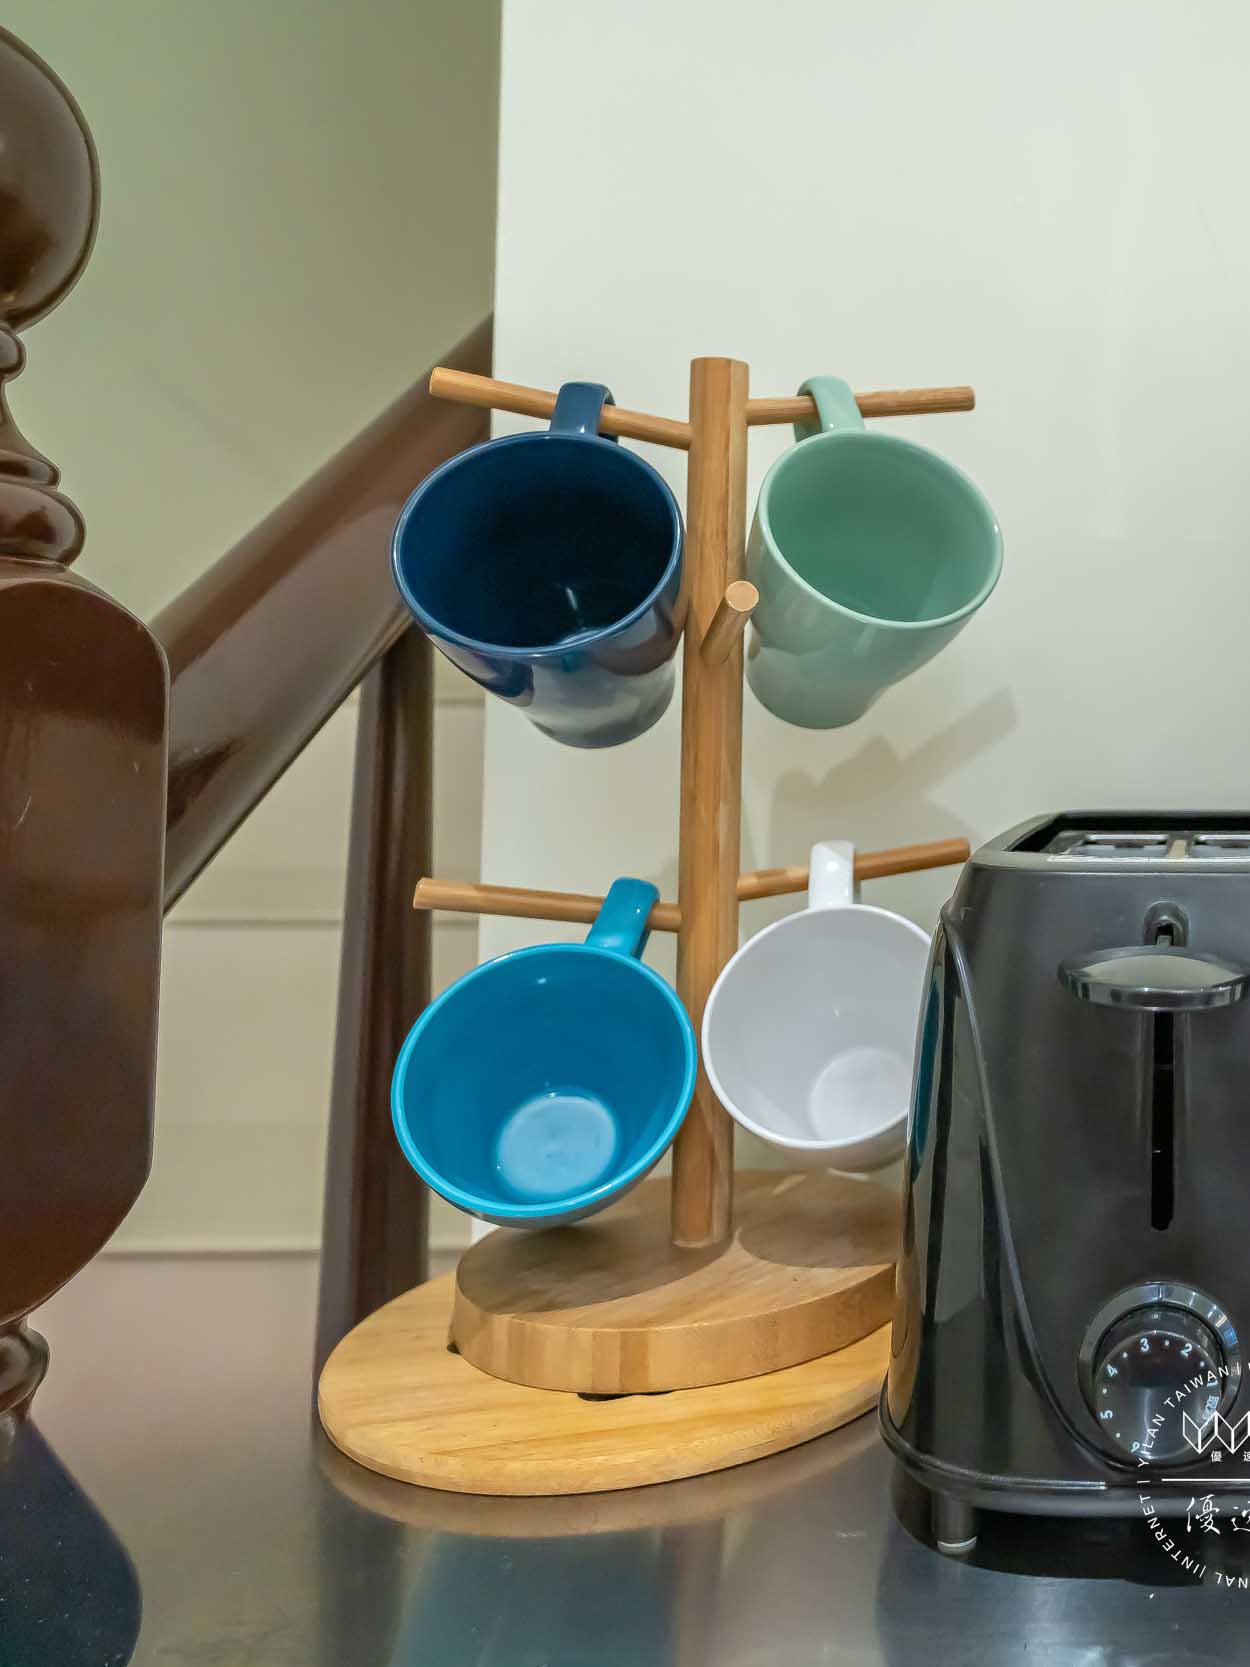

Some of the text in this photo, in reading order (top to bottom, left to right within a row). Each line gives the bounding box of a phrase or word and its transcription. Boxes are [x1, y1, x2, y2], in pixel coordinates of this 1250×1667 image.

[1140, 1338, 1150, 1352] 3
[1180, 1343, 1193, 1357] 2
[1106, 1364, 1118, 1377] 4
[1100, 1410, 1113, 1420] 5
